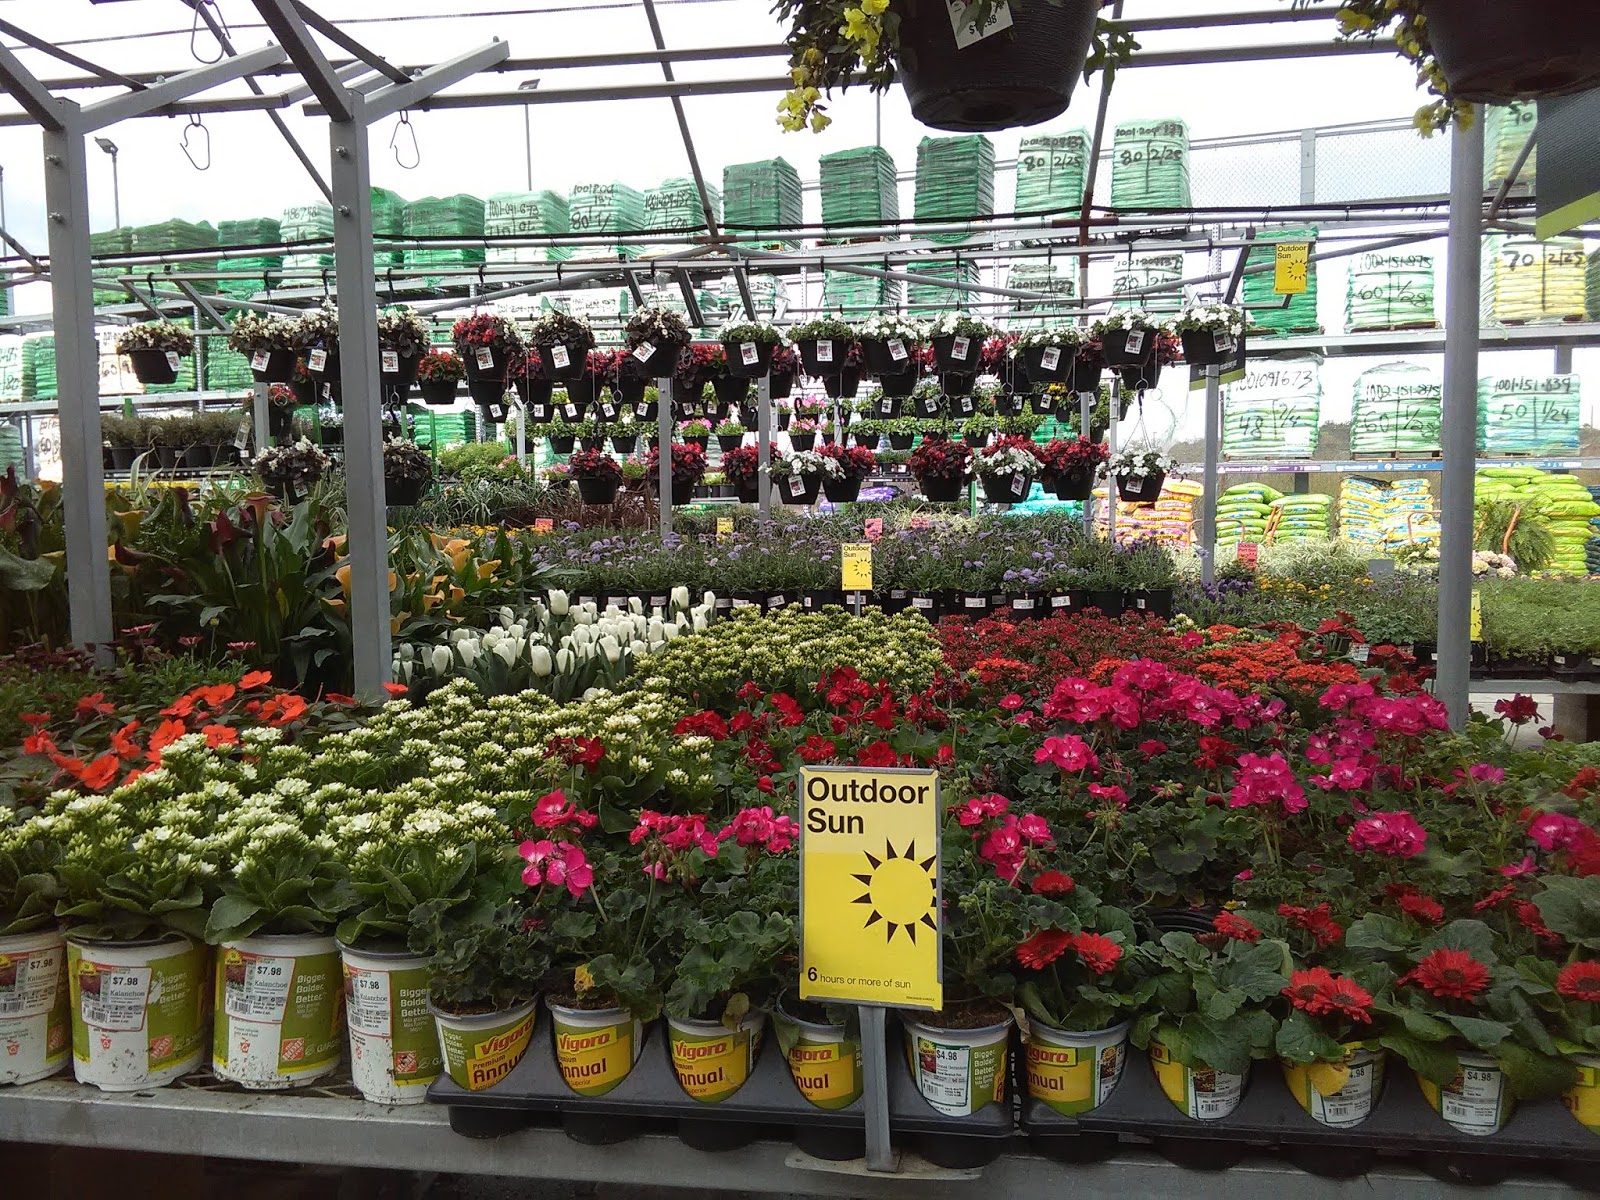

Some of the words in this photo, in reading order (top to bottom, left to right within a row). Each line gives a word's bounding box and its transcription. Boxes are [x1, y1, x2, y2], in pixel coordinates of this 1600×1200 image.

[1024, 155, 1045, 171] 80
[1120, 150, 1142, 166] 80
[571, 211, 590, 230] 80
[1501, 249, 1534, 271] 70
[1499, 403, 1528, 421] 50
[807, 777, 929, 804] Outdoor
[807, 808, 864, 834] Sun
[30, 959, 53, 970] $7.98
[257, 966, 282, 976] $7.98
[112, 976, 138, 986] $7.98
[360, 980, 380, 990] $7.98
[807, 966, 818, 981] 6
[820, 974, 845, 983] hours
[858, 978, 881, 987] more
[883, 979, 893, 987] of
[894, 980, 911, 989] sun
[110, 989, 145, 997] Kalanchoe
[400, 988, 430, 997] Bigge
[400, 998, 426, 1008] Bolde
[481, 1017, 532, 1055] Vigoro
[560, 1033, 610, 1052] Vigoro
[676, 1042, 727, 1060] Vigoro
[790, 1049, 832, 1062] igoro
[936, 1050, 958, 1061] $4.98
[472, 1054, 506, 1069] Premium
[679, 1067, 723, 1086] nnual
[1348, 1068, 1365, 1079] 4.98
[796, 1074, 829, 1089] nual
